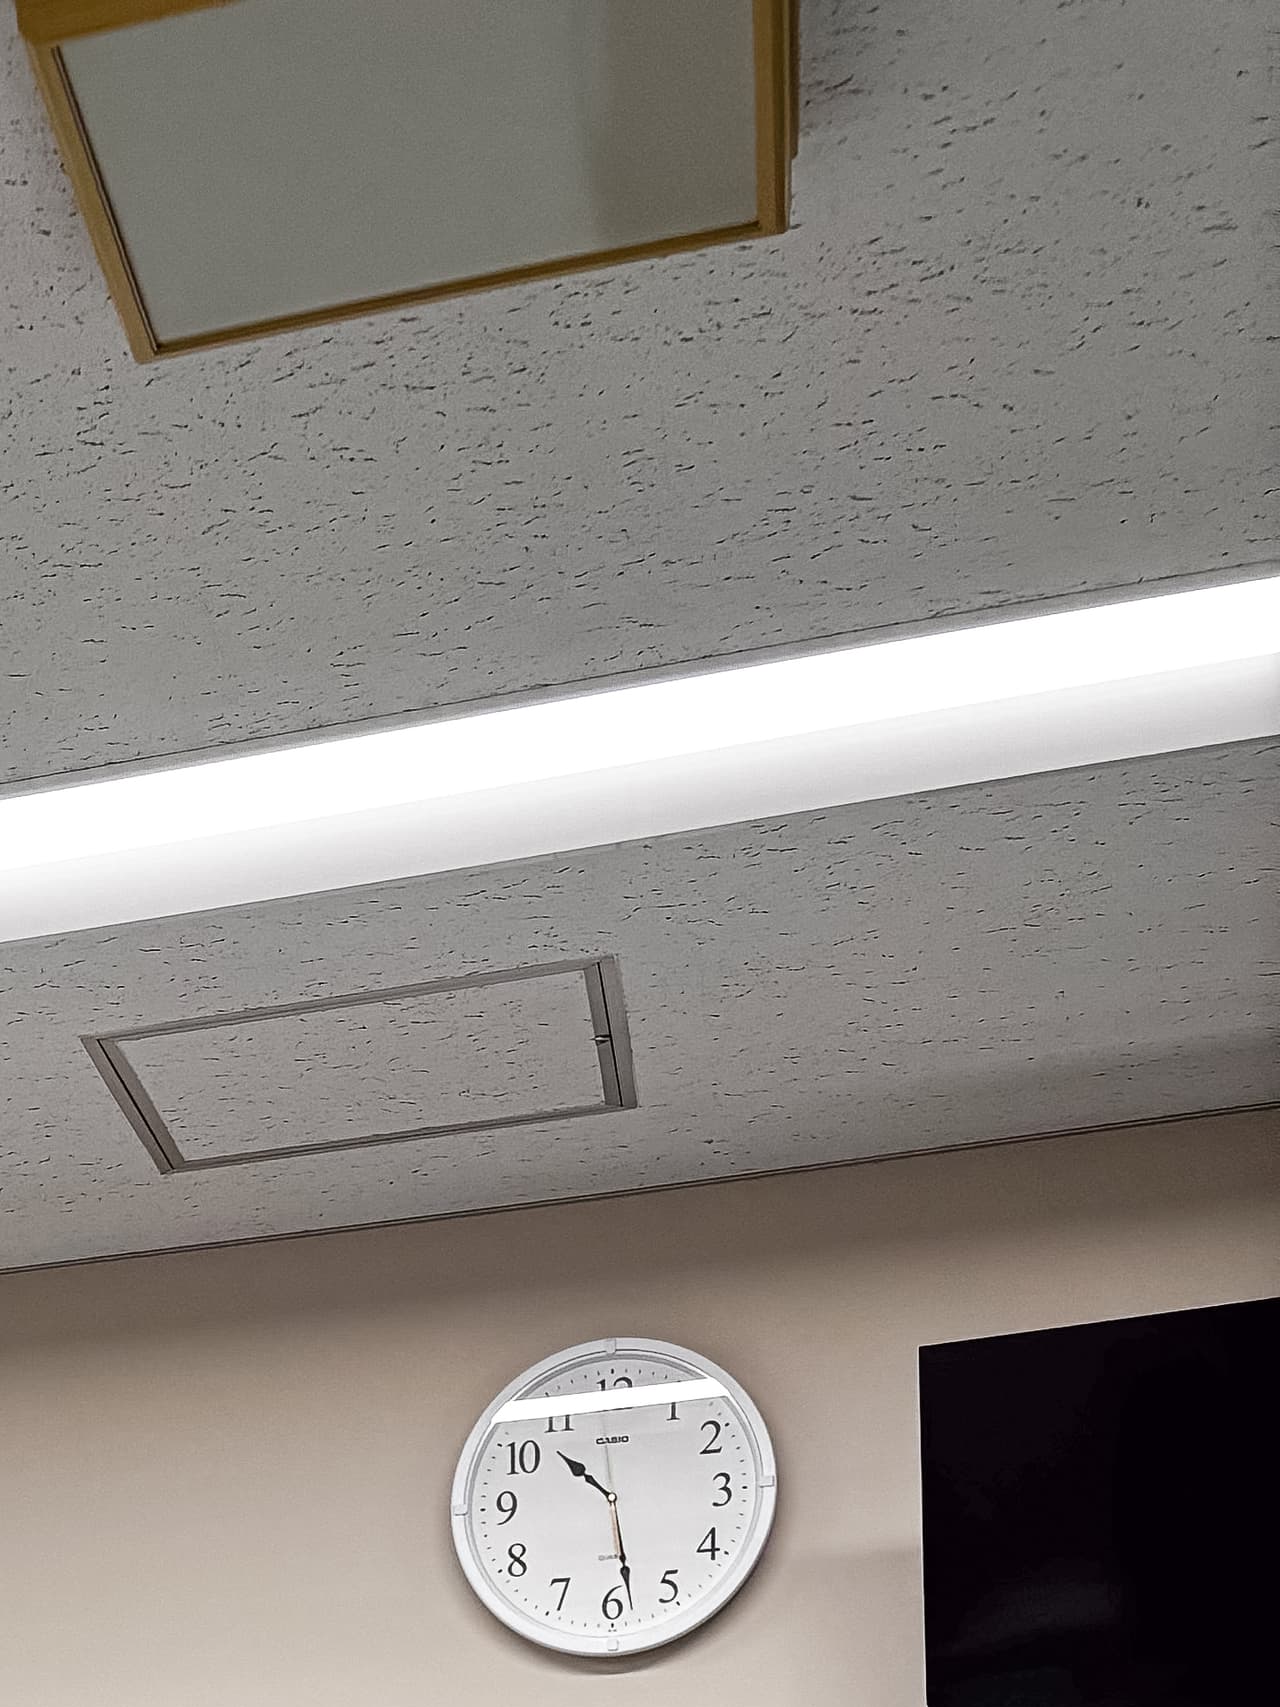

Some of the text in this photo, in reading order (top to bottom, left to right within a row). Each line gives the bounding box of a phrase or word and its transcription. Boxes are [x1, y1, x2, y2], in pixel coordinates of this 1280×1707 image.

[699, 1420, 723, 1455] 2
[506, 1440, 541, 1476] 10
[712, 1472, 733, 1507] 3
[496, 1490, 518, 1526] 9
[507, 1543, 527, 1578] 8
[696, 1526, 721, 1561] 4
[550, 1577, 571, 1611] 7
[601, 1585, 624, 1620] 6
[658, 1569, 679, 1604] 5
